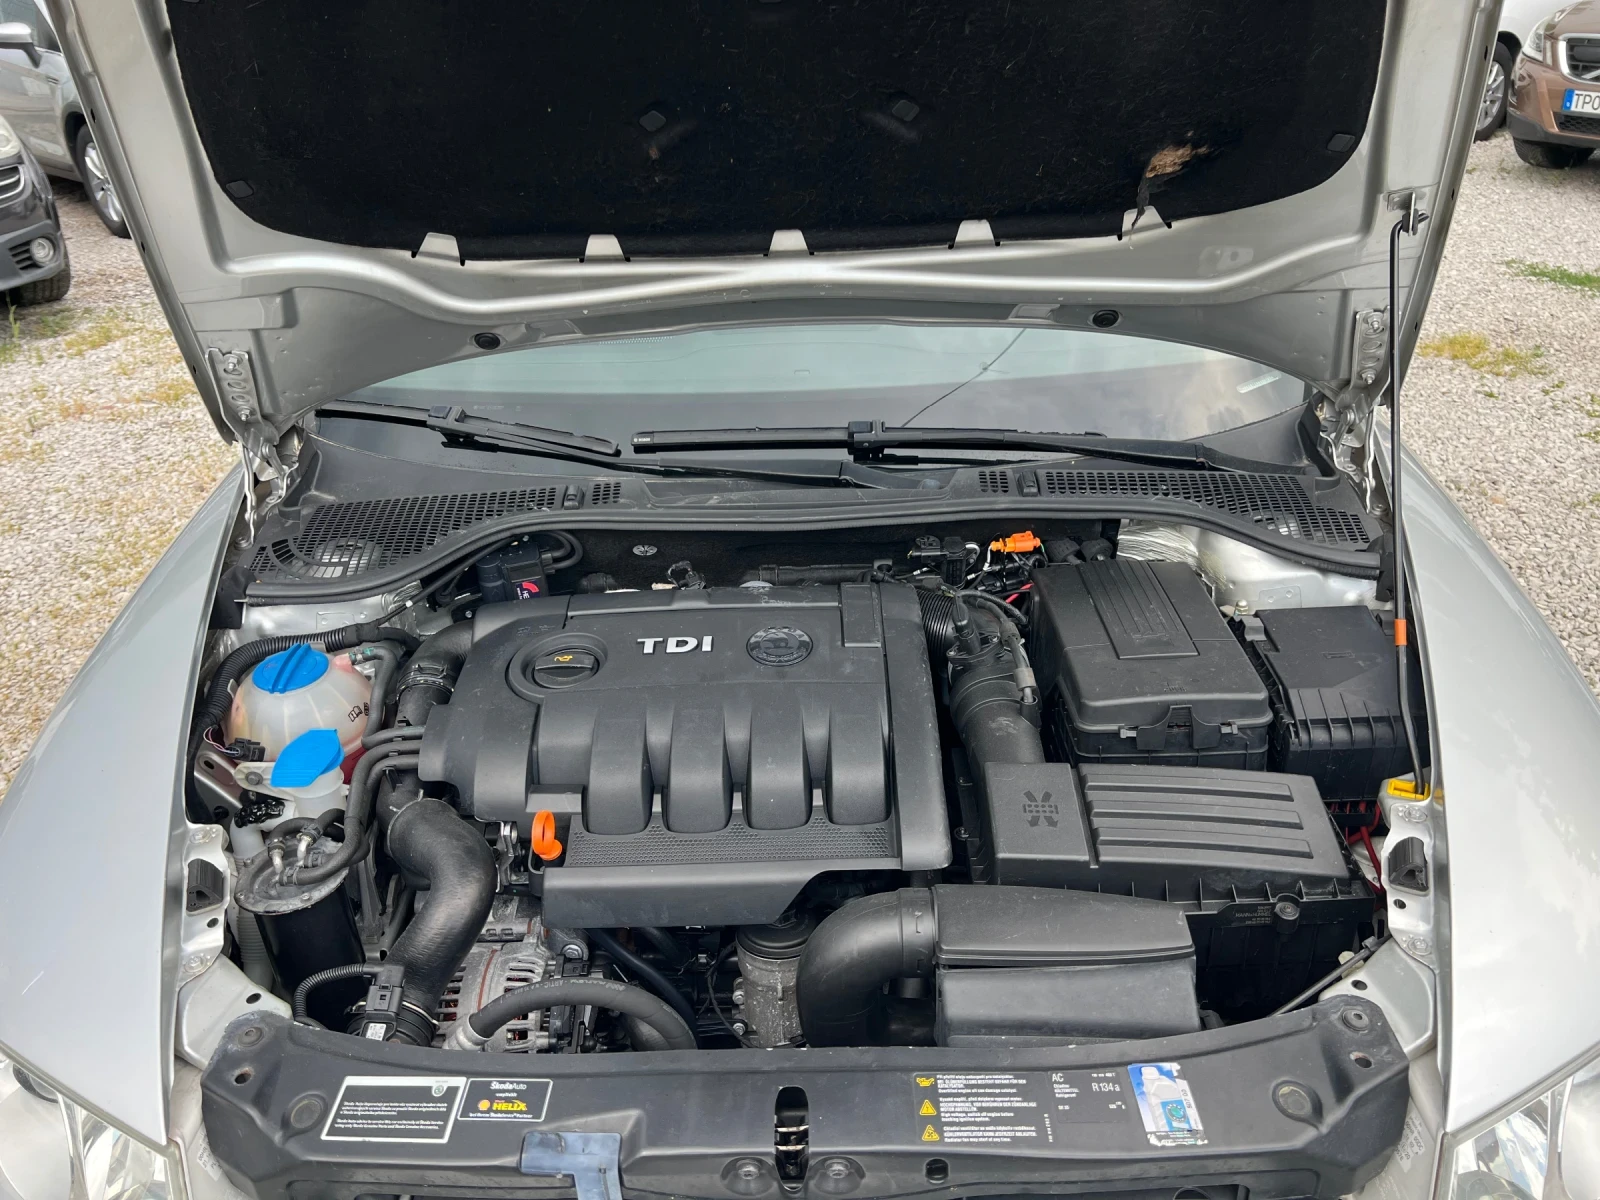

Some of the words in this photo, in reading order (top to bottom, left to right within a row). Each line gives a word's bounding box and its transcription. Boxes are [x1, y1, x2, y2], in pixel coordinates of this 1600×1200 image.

[637, 635, 713, 654] TDI
[1052, 1073, 1064, 1082] AC
[492, 1101, 527, 1110] HELIX
